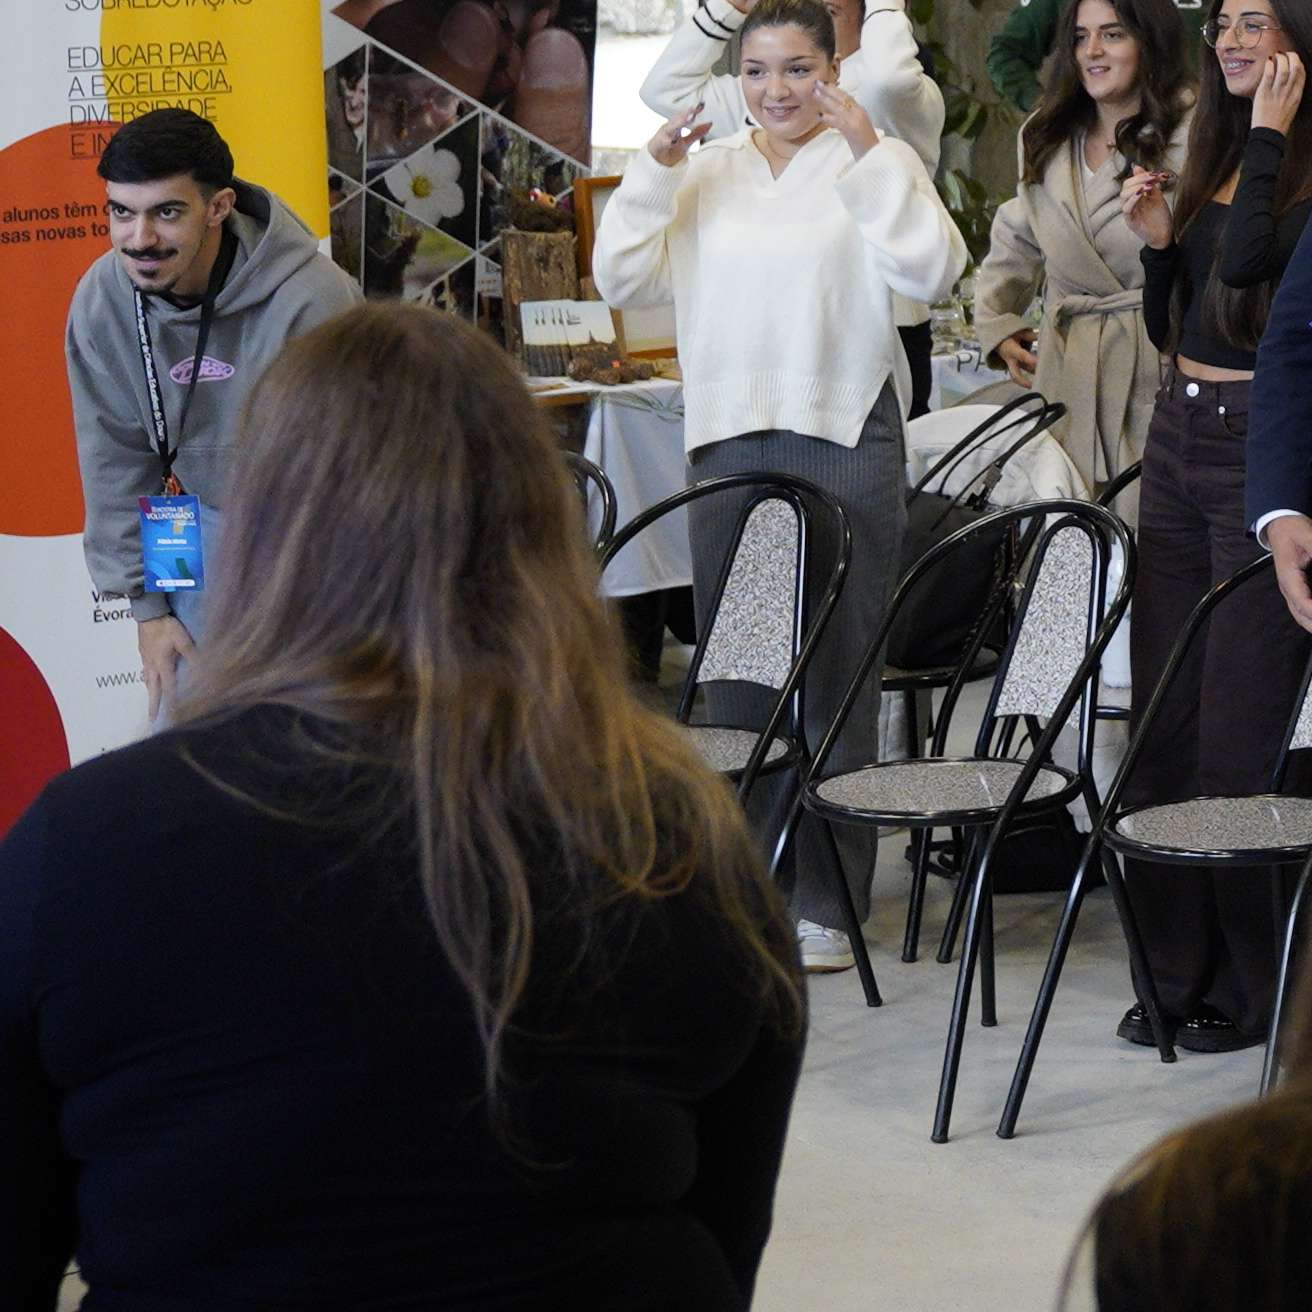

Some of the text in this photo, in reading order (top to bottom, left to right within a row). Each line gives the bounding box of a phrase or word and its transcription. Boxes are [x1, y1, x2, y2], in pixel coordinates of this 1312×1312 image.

[67, 41, 228, 69] EDUCAR PARA
[68, 66, 232, 97] A EXCELÊNCIA,
[71, 134, 84, 157] E
[3, 205, 60, 223] alunos
[64, 201, 97, 218] têm
[36, 225, 86, 240] novas
[91, 223, 111, 238] to
[154, 411, 161, 420] do
